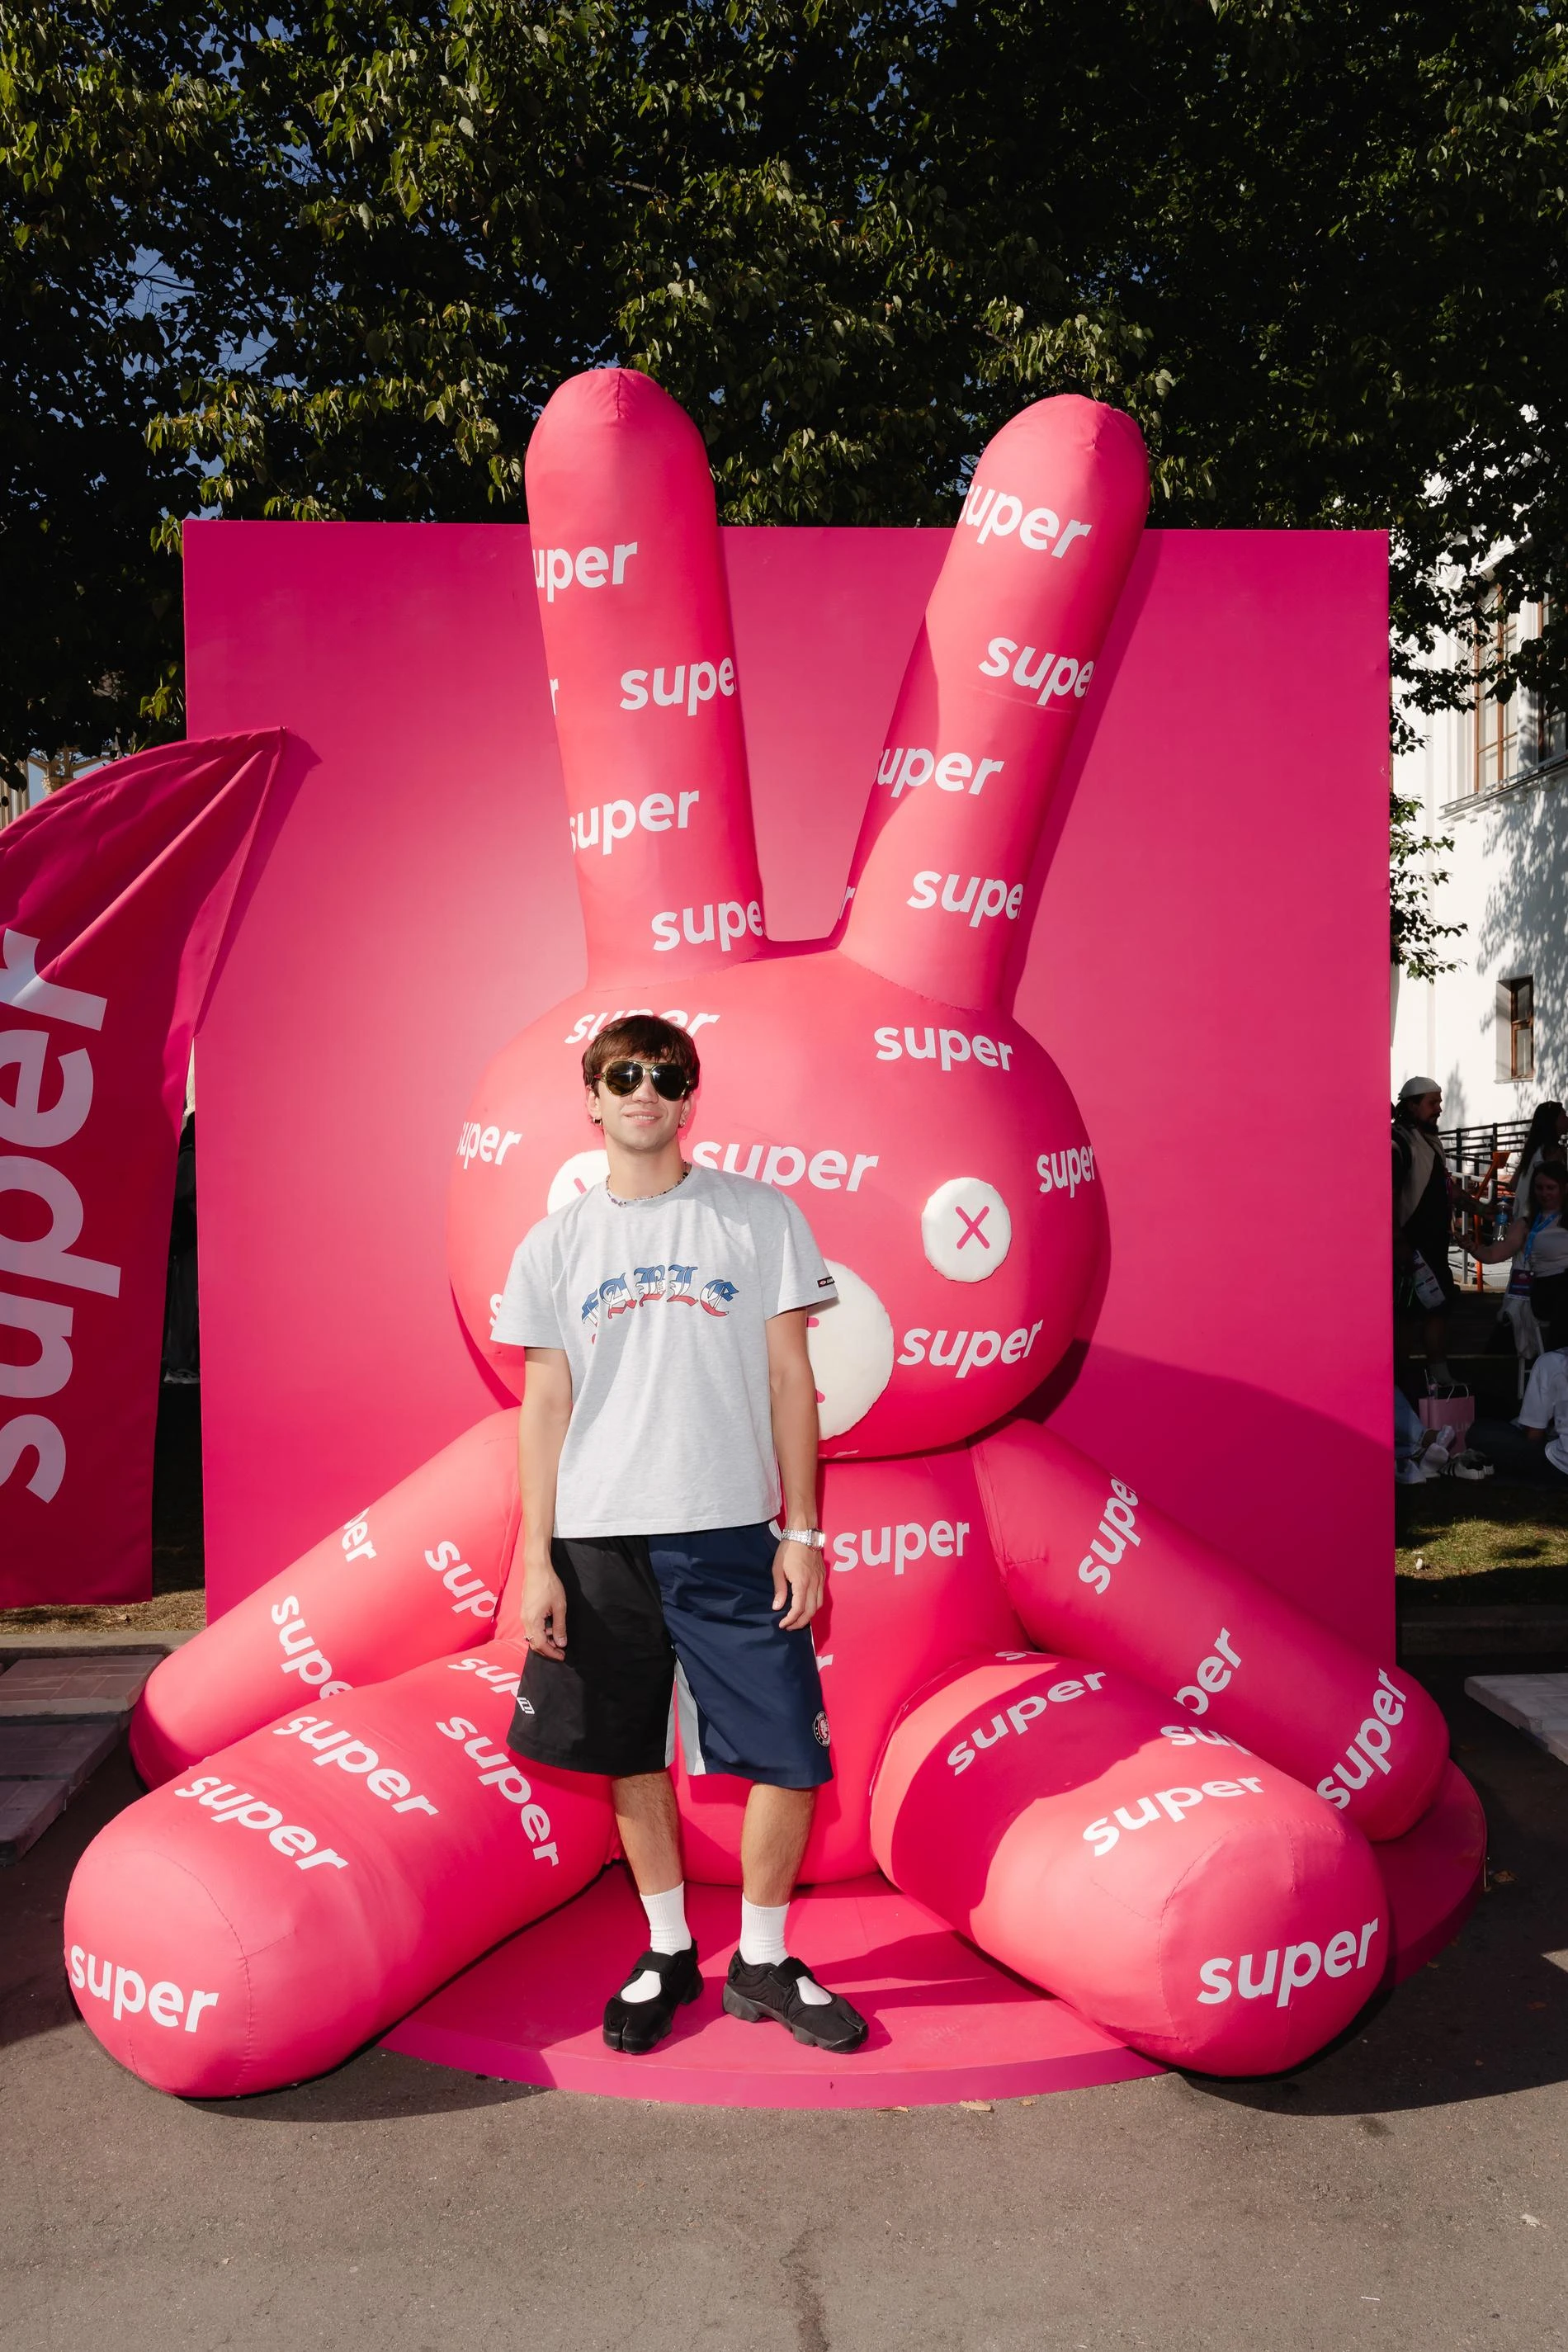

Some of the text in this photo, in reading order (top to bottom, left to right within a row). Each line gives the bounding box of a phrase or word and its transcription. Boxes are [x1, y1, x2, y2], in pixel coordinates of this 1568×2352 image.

[977, 636, 1096, 706] supe
[876, 747, 1005, 798] uper
[906, 870, 1024, 928] supe
[873, 1027, 1013, 1071] super
[456, 1122, 523, 1169] uper
[692, 1141, 879, 1193] super
[1037, 1145, 1095, 1198] super
[897, 1319, 1044, 1378] super
[832, 1520, 971, 1576] super
[1078, 1474, 1141, 1594] supe
[424, 1540, 499, 1623] sup
[947, 1670, 1107, 1776] super
[1316, 1667, 1407, 1810] super
[272, 1715, 440, 1816] super
[436, 1716, 560, 1868] super
[173, 1776, 350, 1872] super
[1082, 1773, 1265, 1857] super
[70, 1944, 220, 2034] super
[1197, 1917, 1379, 2008] super
